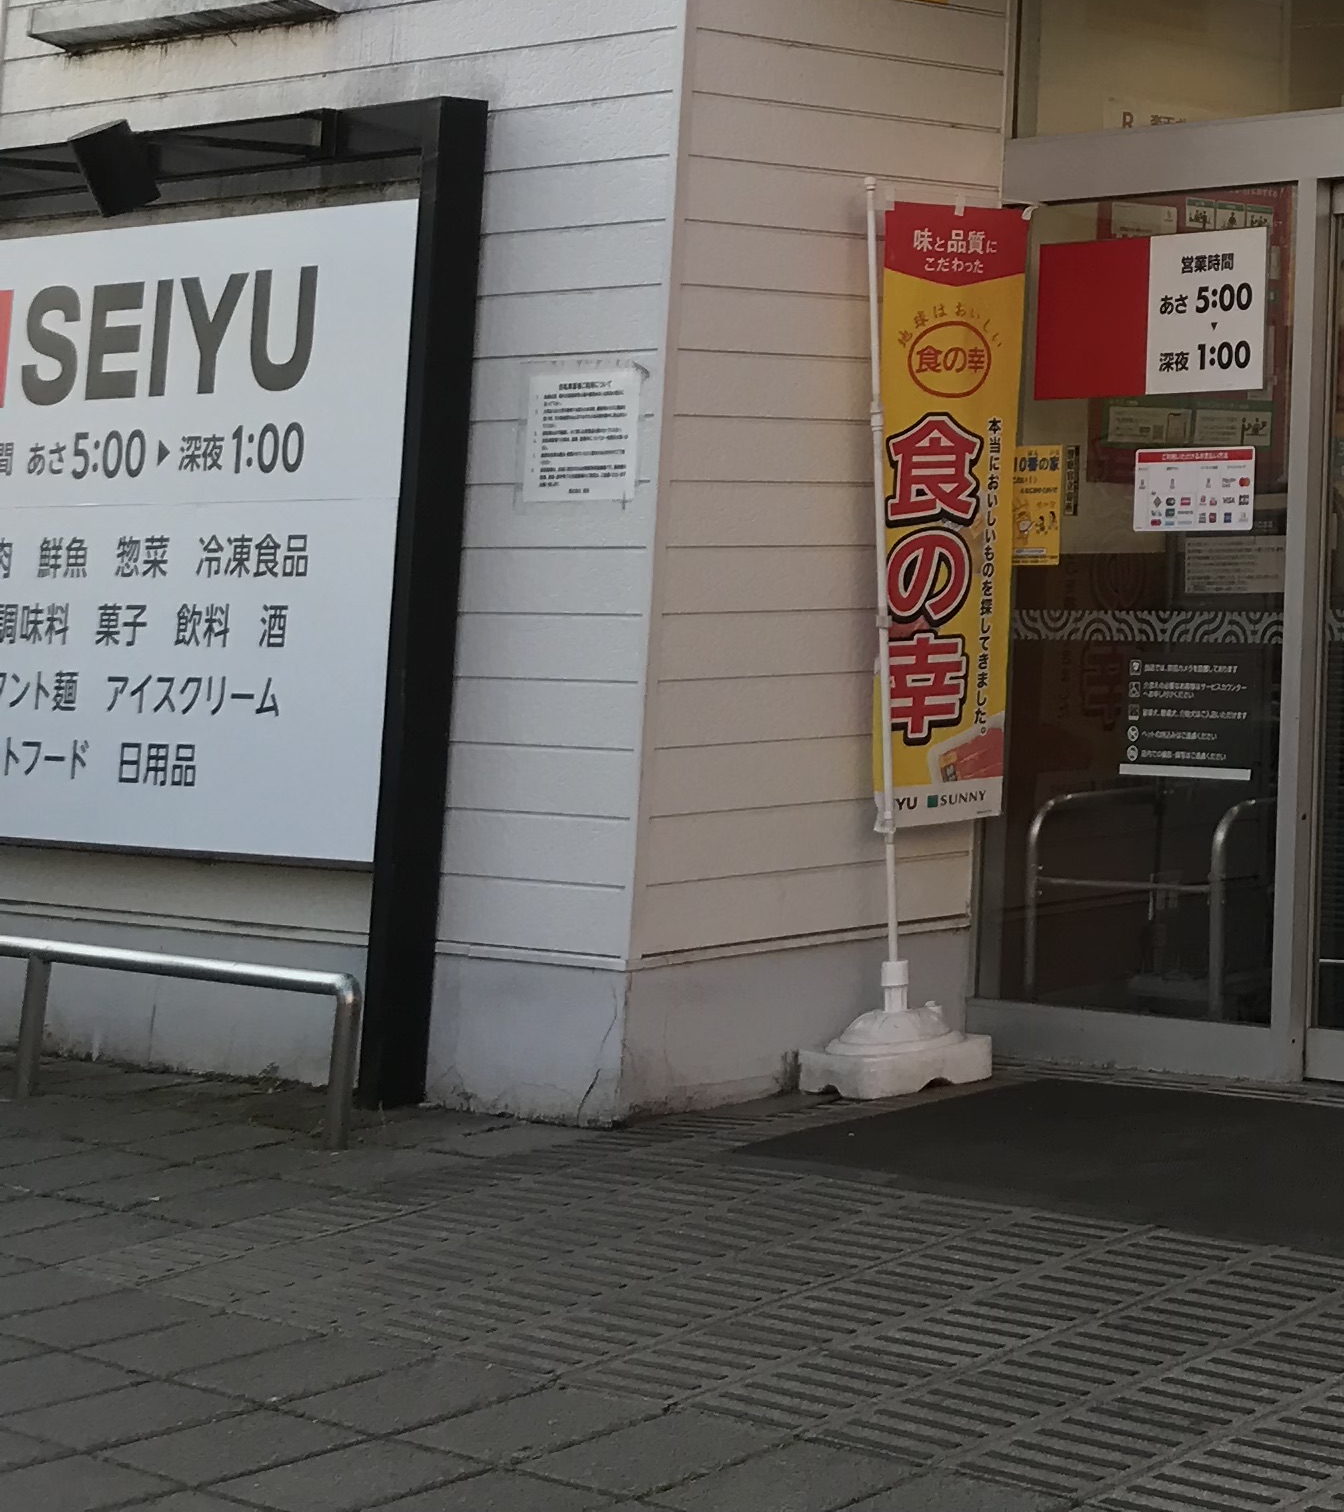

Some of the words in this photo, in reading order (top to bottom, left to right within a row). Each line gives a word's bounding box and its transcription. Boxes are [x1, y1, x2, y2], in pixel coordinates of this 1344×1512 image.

[913, 228, 998, 255] 味と品質に
[924, 257, 984, 274] こだわった
[1181, 253, 1234, 274] 営業時間
[1159, 294, 1189, 315] あさ
[1196, 282, 1253, 314] 5:00
[21, 264, 319, 406] SEIYU
[1159, 351, 1190, 373] 深夜
[1197, 340, 1251, 371] 1:00
[916, 345, 985, 374] 食の幸
[27, 441, 67, 476] あさ
[71, 428, 147, 480] 5:00
[178, 434, 226, 472] 深夜
[231, 421, 305, 474] 1:00
[37, 536, 88, 579] 鮮魚
[114, 535, 170, 579] 惣菜
[195, 533, 309, 579] 冷凍食品
[974, 417, 1002, 735] 本当においしいものを探してきました。
[886, 414, 982, 742] 食の幸
[95, 603, 147, 647] 菓子
[174, 603, 230, 648] 飲料
[259, 604, 289, 648] 酒
[106, 674, 280, 717] アイスクリーム
[4, 736, 89, 779] トフード
[118, 742, 196, 787] 日用品
[940, 790, 987, 806] SUNNY
